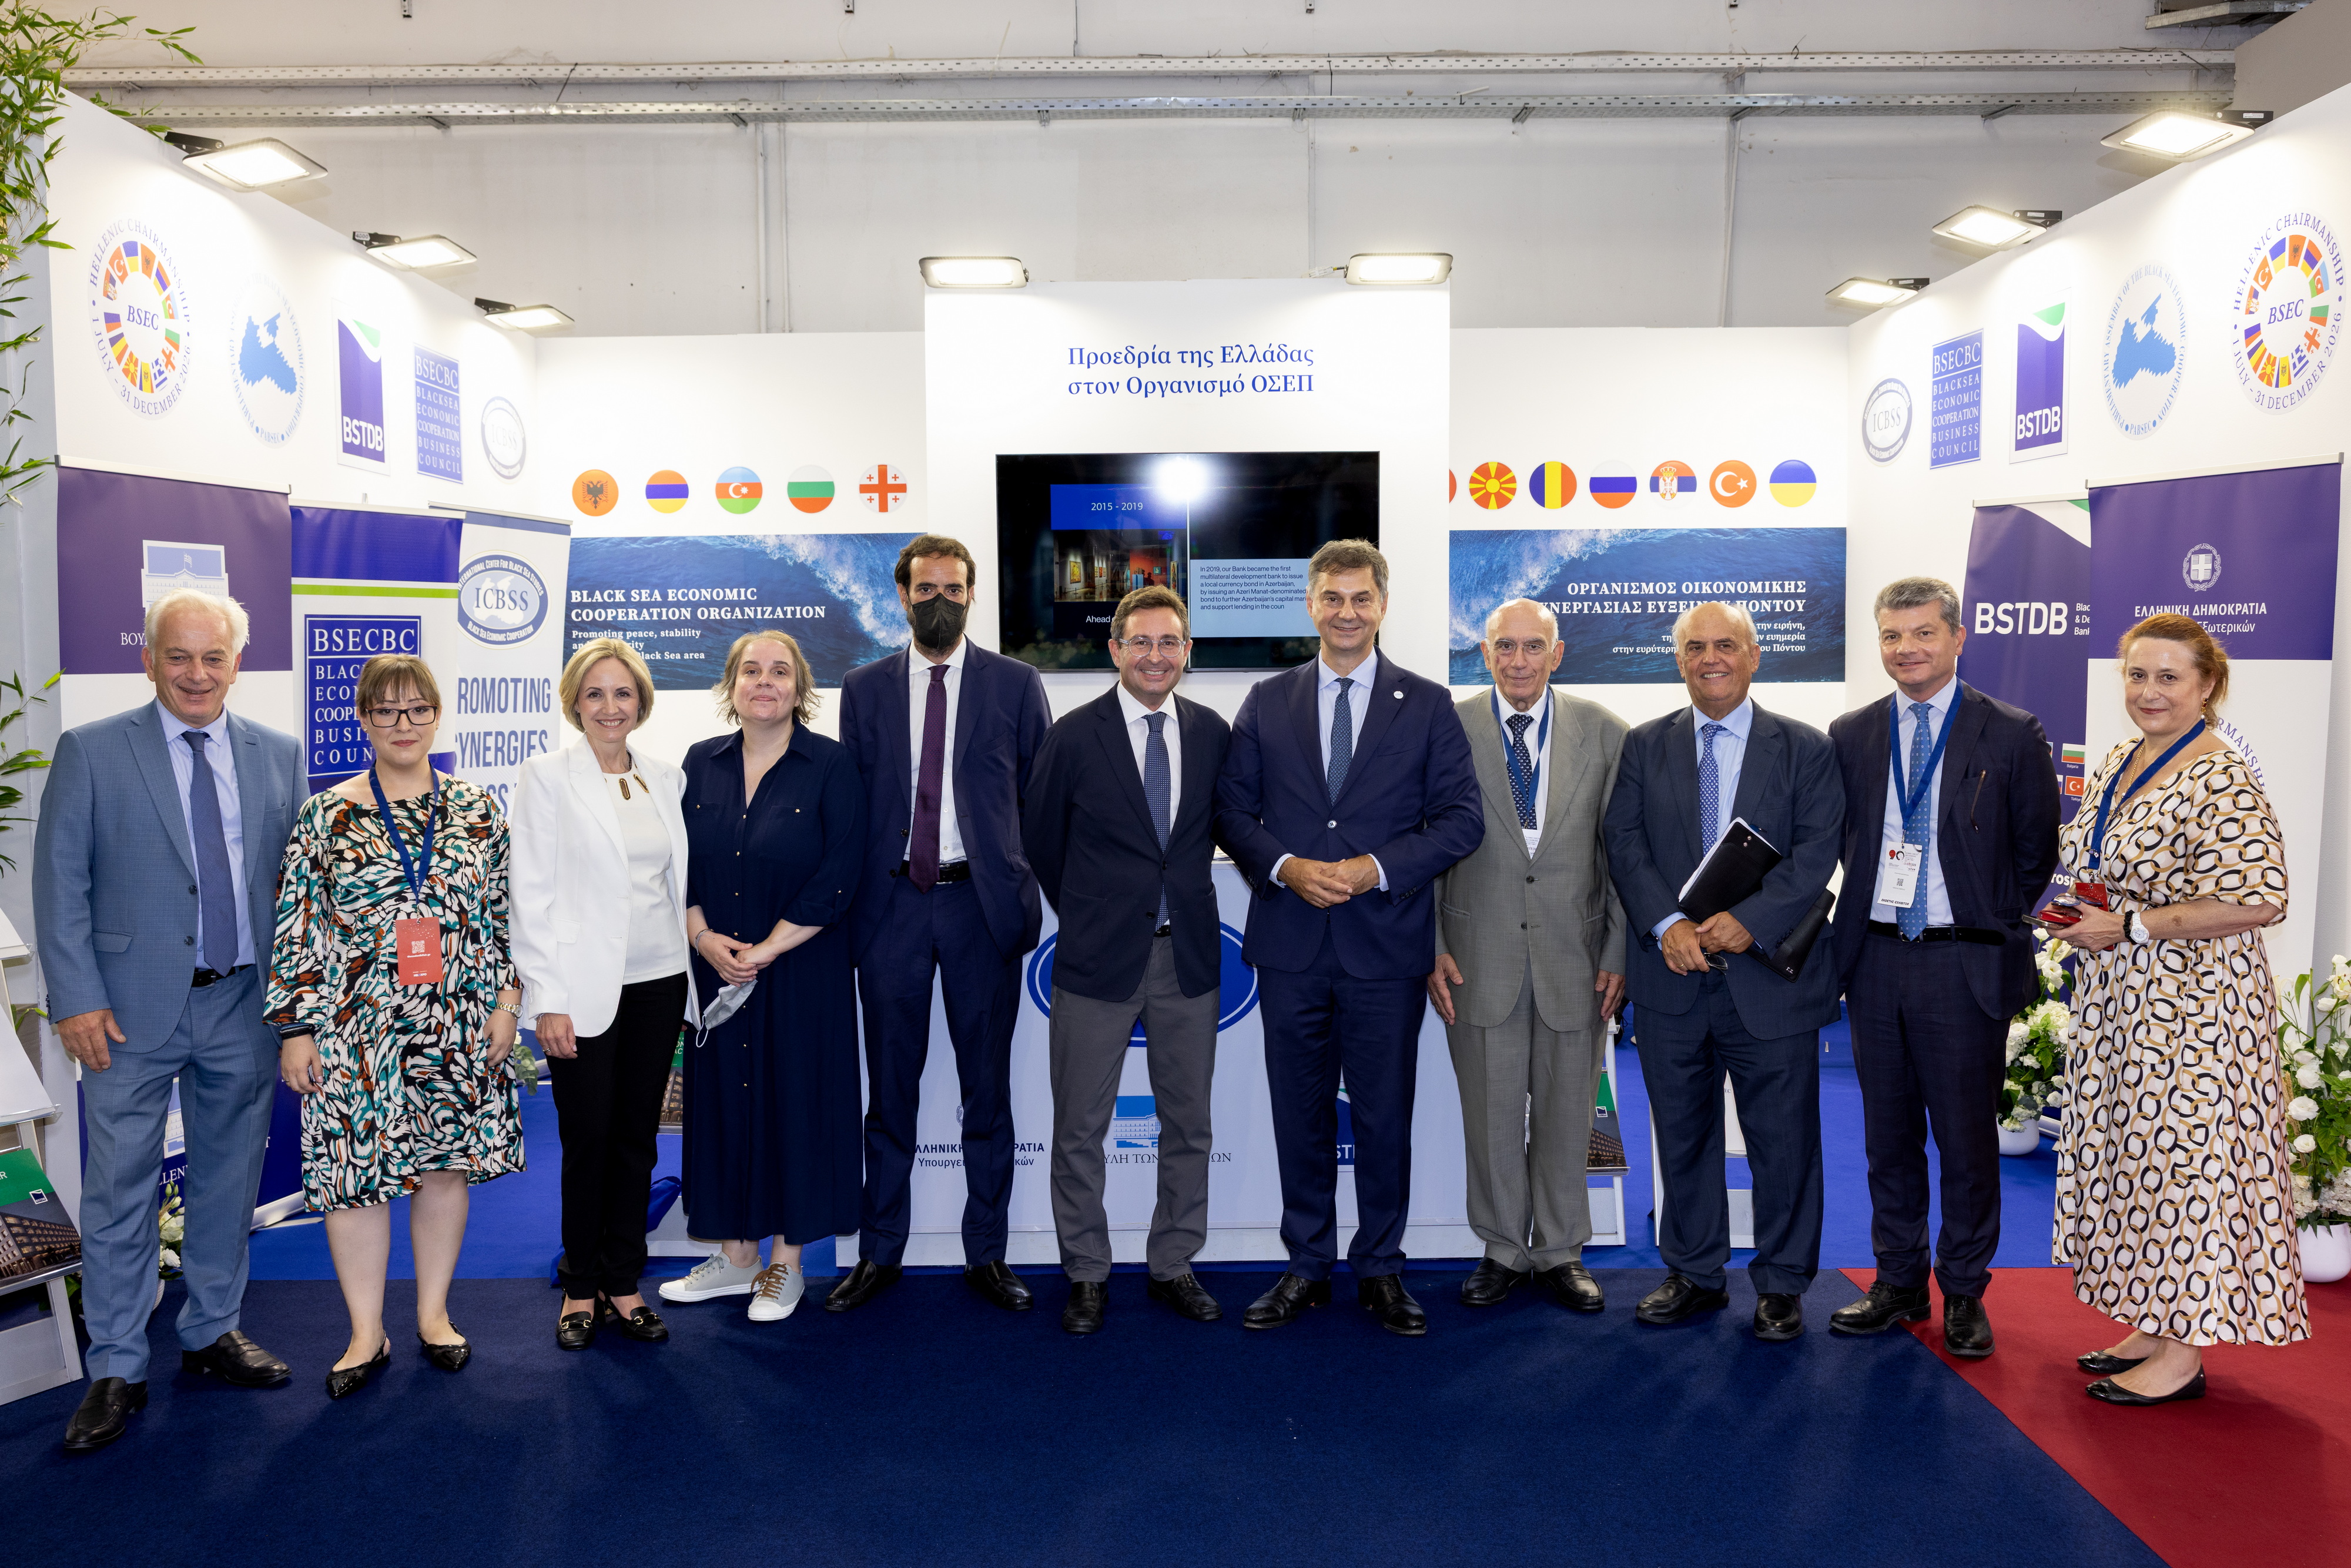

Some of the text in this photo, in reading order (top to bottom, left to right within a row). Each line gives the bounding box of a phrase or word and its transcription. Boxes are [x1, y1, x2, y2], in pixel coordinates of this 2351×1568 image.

[90, 219, 125, 287] HELLENIC
[128, 219, 190, 323] CHAIRMANSHIP
[2233, 212, 2344, 311] HELLENIC CHAIRMANSHIP
[126, 304, 159, 330] BSEC
[2268, 299, 2304, 324] BSEC
[1068, 343, 1314, 368] Προεδρία της Ελλάδας
[1934, 341, 1980, 374] BSECBC
[2103, 264, 2186, 428] PARLIAMENTARY ASSEMBLY OF THE BLACK SEA ECONOMIC COOPERATION
[415, 354, 458, 389] BSECBC
[2233, 353, 2250, 387] JULY
[2255, 390, 2265, 406] 31
[2268, 363, 2326, 410] DECEMBER
[2323, 312, 2342, 356] 2026
[94, 330, 114, 373] JULY
[120, 384, 130, 402] 31
[133, 386, 182, 416] DECEMBER
[179, 346, 191, 385] 2026
[1068, 373, 1314, 398] στον Οργανισμό ΟΣΕΠ
[1933, 389, 1980, 411] ECONOMIC
[417, 403, 460, 427] ECONOMIC
[1873, 407, 1901, 432] ICBSS
[1933, 406, 1979, 427] COOPERATION
[2017, 406, 2061, 440] BSTDB
[260, 427, 280, 444] PABSEC
[343, 416, 384, 451] BSTDB
[417, 419, 460, 442] COOPERATION
[492, 424, 517, 450] ICBSS
[1932, 423, 1979, 444] BUSINESS
[2129, 420, 2152, 435] PABSEC
[418, 435, 461, 458] BUSINESS
[1932, 439, 1978, 459] COUNCIL
[418, 453, 461, 474] COUNCIL
[1091, 502, 1113, 511] 2015
[1121, 502, 1143, 510] 2019
[485, 559, 500, 568] CENTER
[500, 559, 508, 568] FOR
[508, 561, 524, 574] BLACK
[523, 567, 531, 579] SEA
[530, 573, 544, 596] STUDIES
[1568, 581, 1806, 595] ΟΡΓΑΝΙΣΜΟΣ ΟΙΚΟΝΟΜΙΚΗΣ
[475, 588, 528, 611] ICBSS
[571, 588, 757, 603] BLACK SEA ECONOMIC
[571, 605, 826, 622] COOPERATION ORGANIZATION
[1975, 602, 2091, 635] BSTDB Blac
[2075, 615, 2080, 623] &
[2192, 602, 2267, 616] ΔΗΜΟΚΡΑΤΙΑ
[487, 631, 506, 641] ECONOMIC
[507, 624, 534, 641] COOPERATION
[572, 628, 701, 640] Promoting peace, stability
[1756, 621, 1806, 631] την ειρήνη,
[1766, 631, 1806, 642] ευημερία
[313, 628, 416, 652] BSECBC
[1636, 644, 1676, 654] ευρύτερη
[1773, 644, 1806, 652] Πόντου
[664, 651, 681, 659] Sea
[457, 677, 551, 714] ROMOTING
[314, 747, 373, 765] COUN
